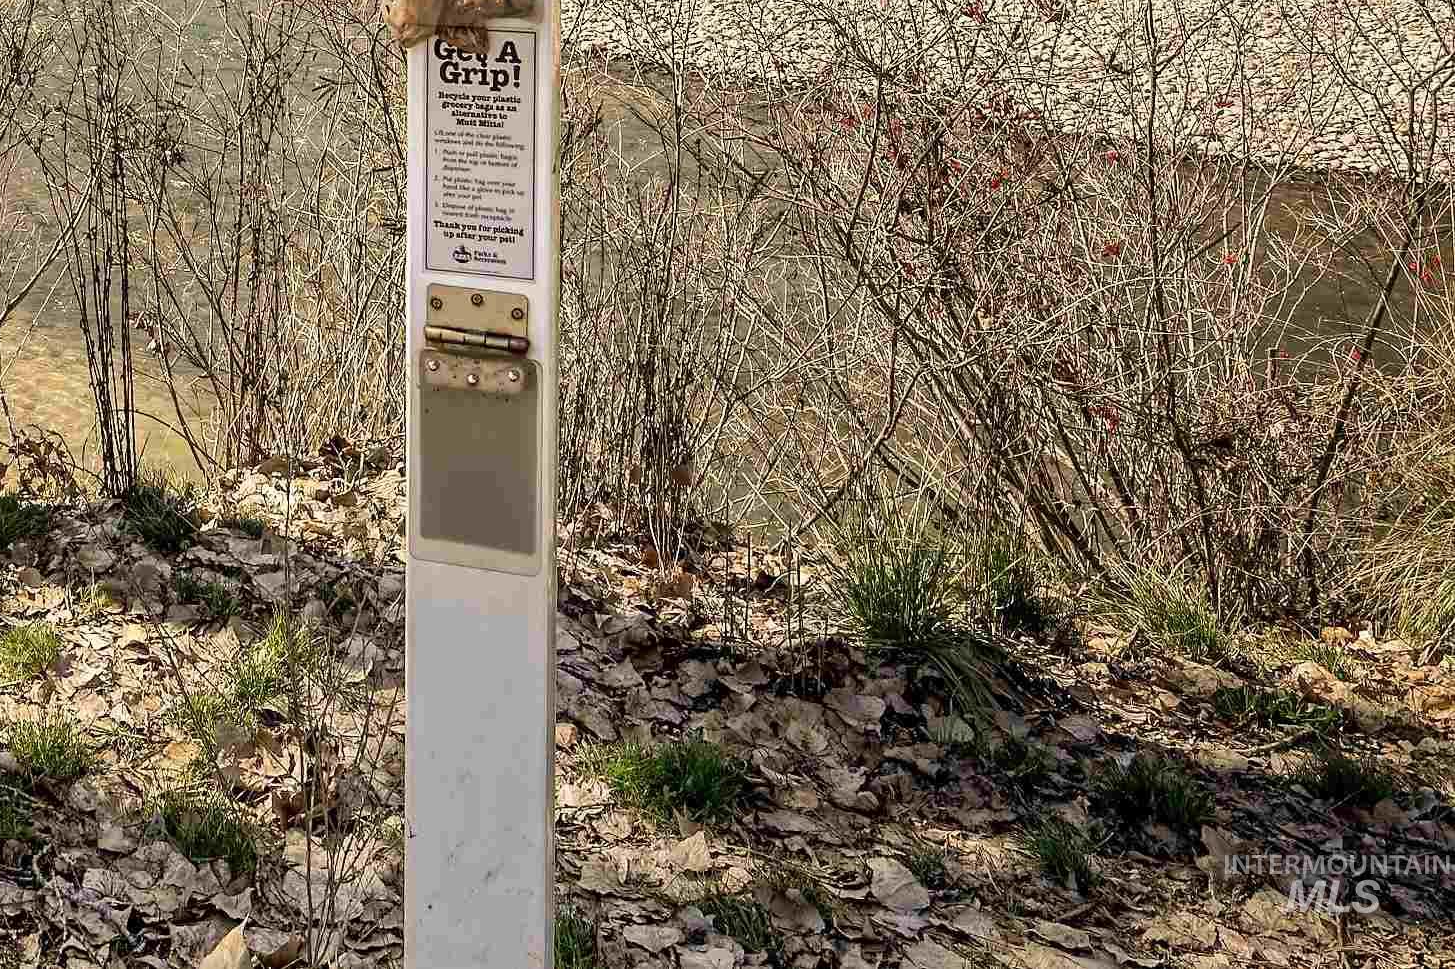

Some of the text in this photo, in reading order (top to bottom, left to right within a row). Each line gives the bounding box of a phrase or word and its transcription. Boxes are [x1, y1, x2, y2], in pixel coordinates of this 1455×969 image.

[496, 41, 521, 63] A
[440, 61, 520, 91] Grip!
[493, 95, 520, 103] plastic
[434, 220, 460, 229] Thank
[462, 223, 476, 231] you
[494, 225, 524, 237] picking
[444, 231, 454, 239] up
[456, 231, 476, 239] after
